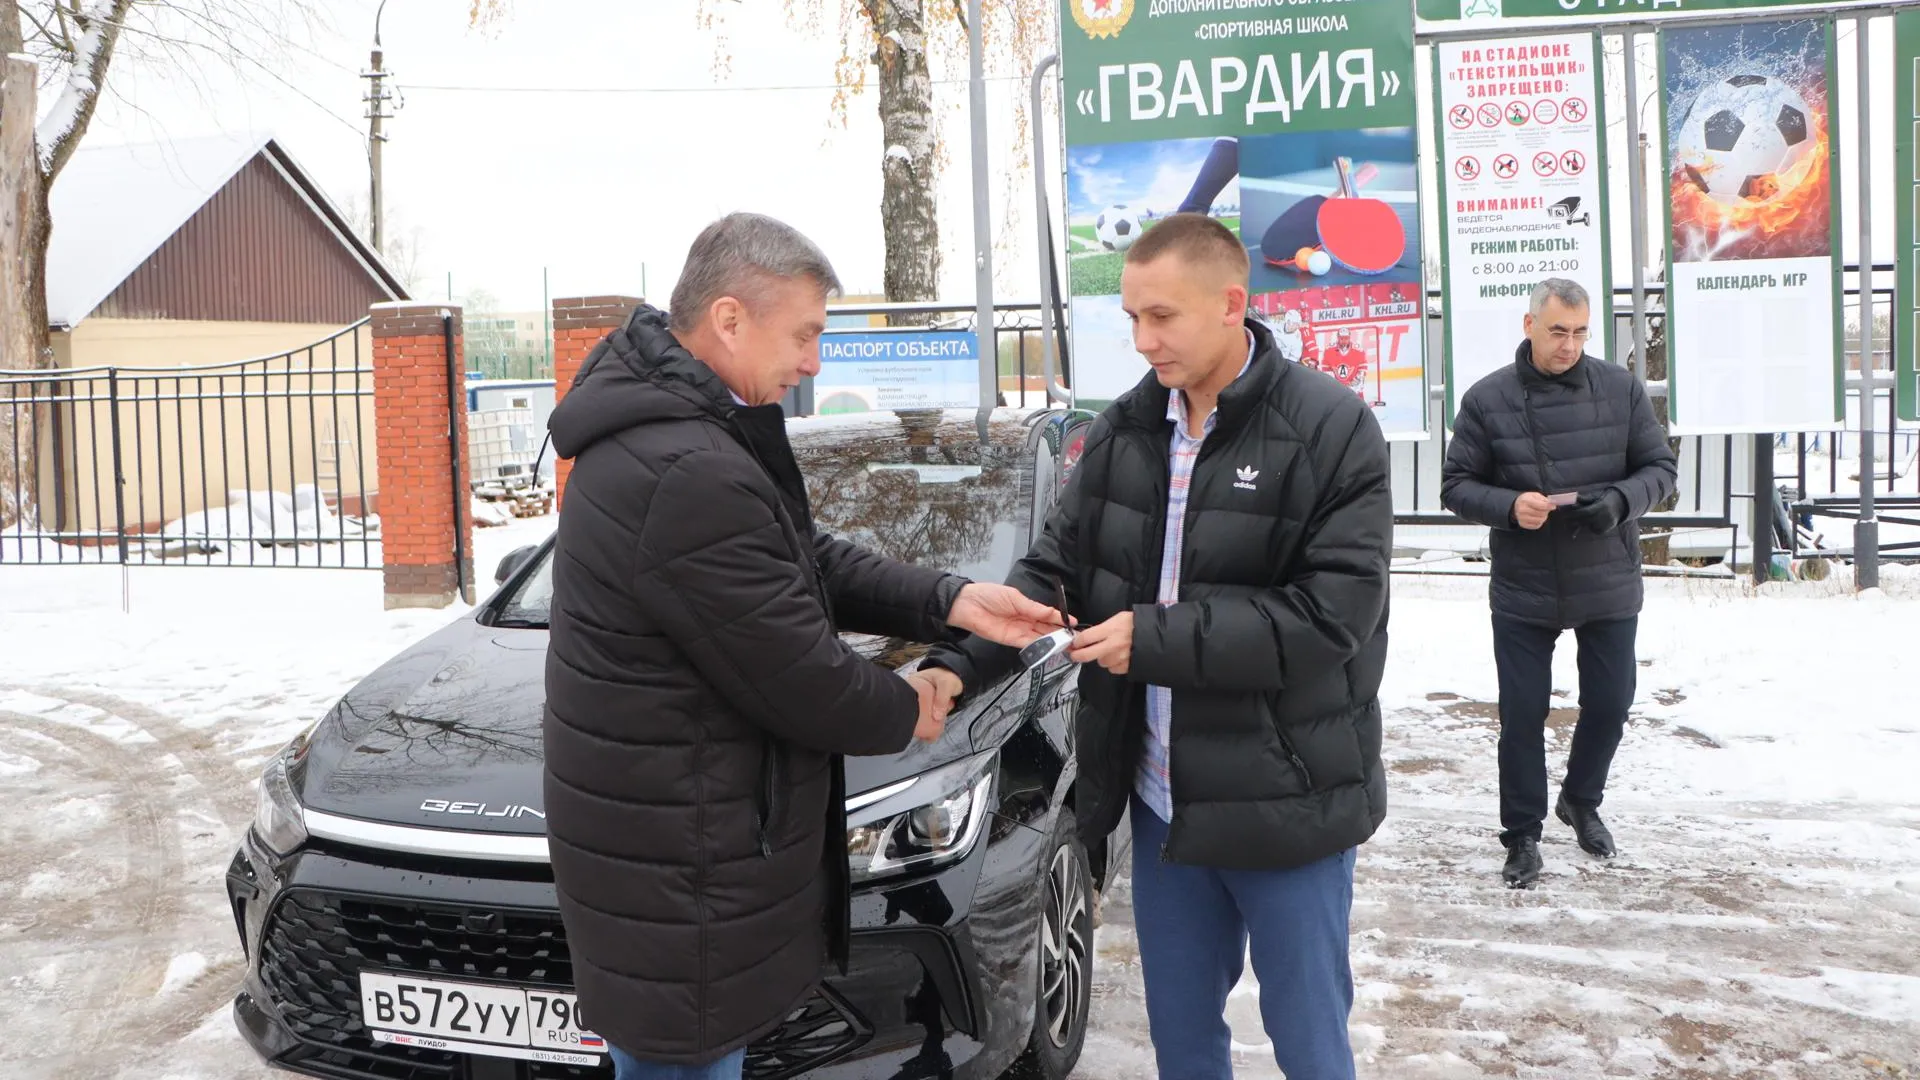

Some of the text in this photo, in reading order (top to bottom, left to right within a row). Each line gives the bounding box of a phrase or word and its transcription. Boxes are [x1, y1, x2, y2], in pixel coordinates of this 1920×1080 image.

[1194, 15, 1349, 40] «СПОРТИВНАЯ ШКОЛА
[1462, 44, 1571, 63] НА СТАДИОНЕ
[1449, 61, 1585, 81] «ТЕКСТИЛЬЩИК»
[1076, 48, 1401, 125] «ГВАРДИЯ»
[1467, 80, 1569, 98] ЗАПРЕЩЕНО:
[1456, 196, 1544, 213] ВНИМАНИЕ!
[1457, 223, 1562, 235] ВИДЕОНАБЛЮДЕНИЕ
[1470, 238, 1579, 255] РЕЖИМ РАБОТЫ:
[1472, 259, 1579, 275] с 8:00 до 21:00
[1480, 283, 1538, 298] ИНФОРМ
[1696, 273, 1808, 291] КАЛЕНДАРЬ ИГР
[1318, 309, 1355, 321] KHL.RU
[1374, 303, 1411, 316] KHL.RU
[822, 340, 970, 358] ПАСПОРТ ОБЪЕКТА
[420, 799, 547, 819] BEIJIN
[548, 1030, 579, 1044] RUS
[532, 1052, 588, 1064] (831) 425-8000
